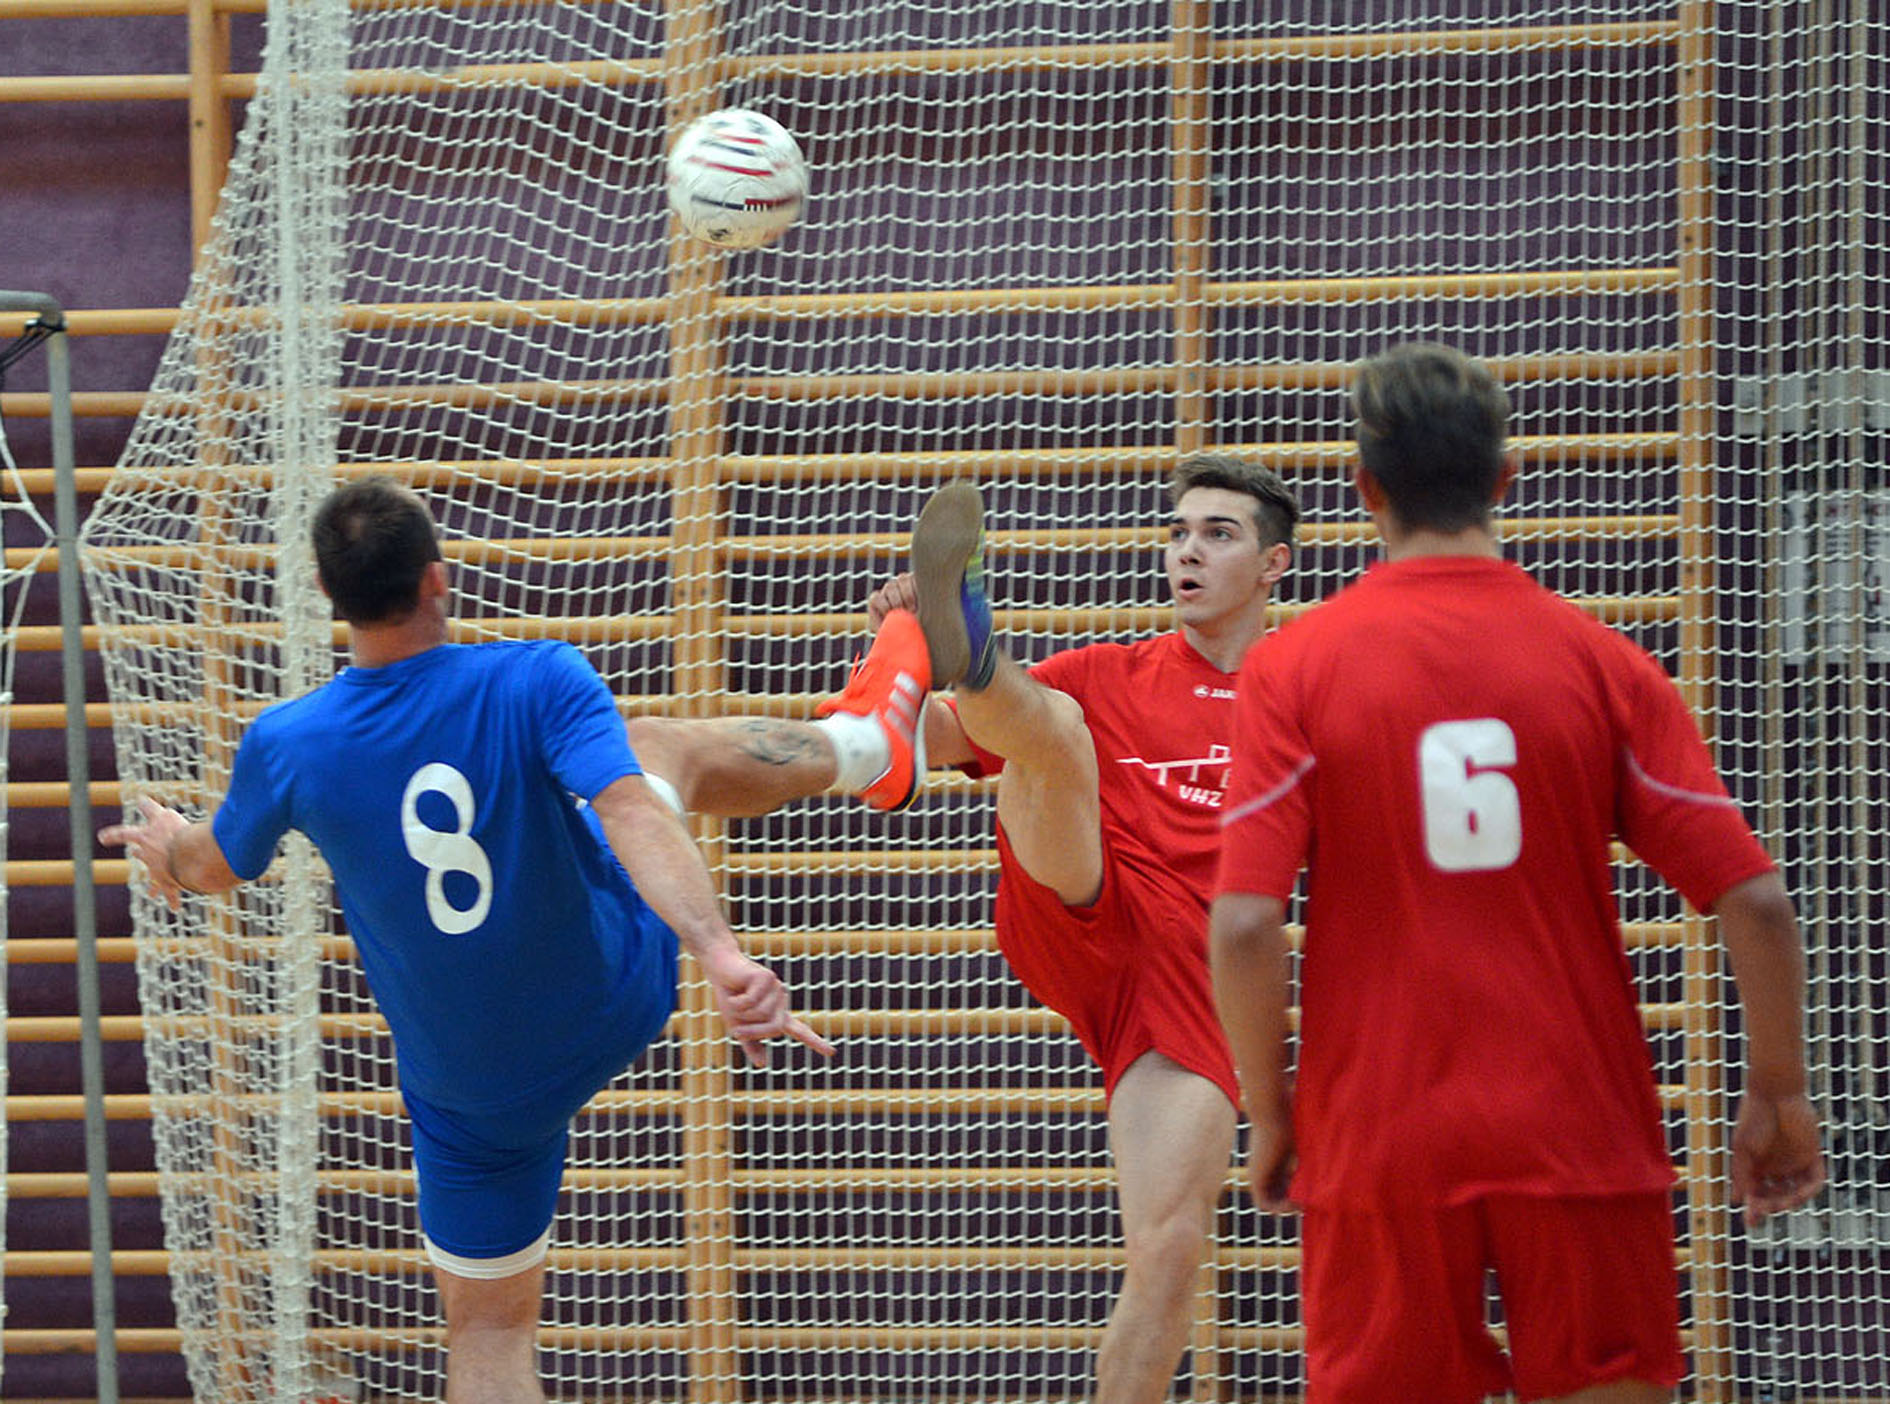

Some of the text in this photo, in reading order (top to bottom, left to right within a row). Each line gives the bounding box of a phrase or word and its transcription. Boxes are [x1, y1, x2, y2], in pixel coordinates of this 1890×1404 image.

[402, 762, 494, 935] 8
[1178, 785, 1224, 807] VHZ
[1419, 718, 1523, 873] 6
